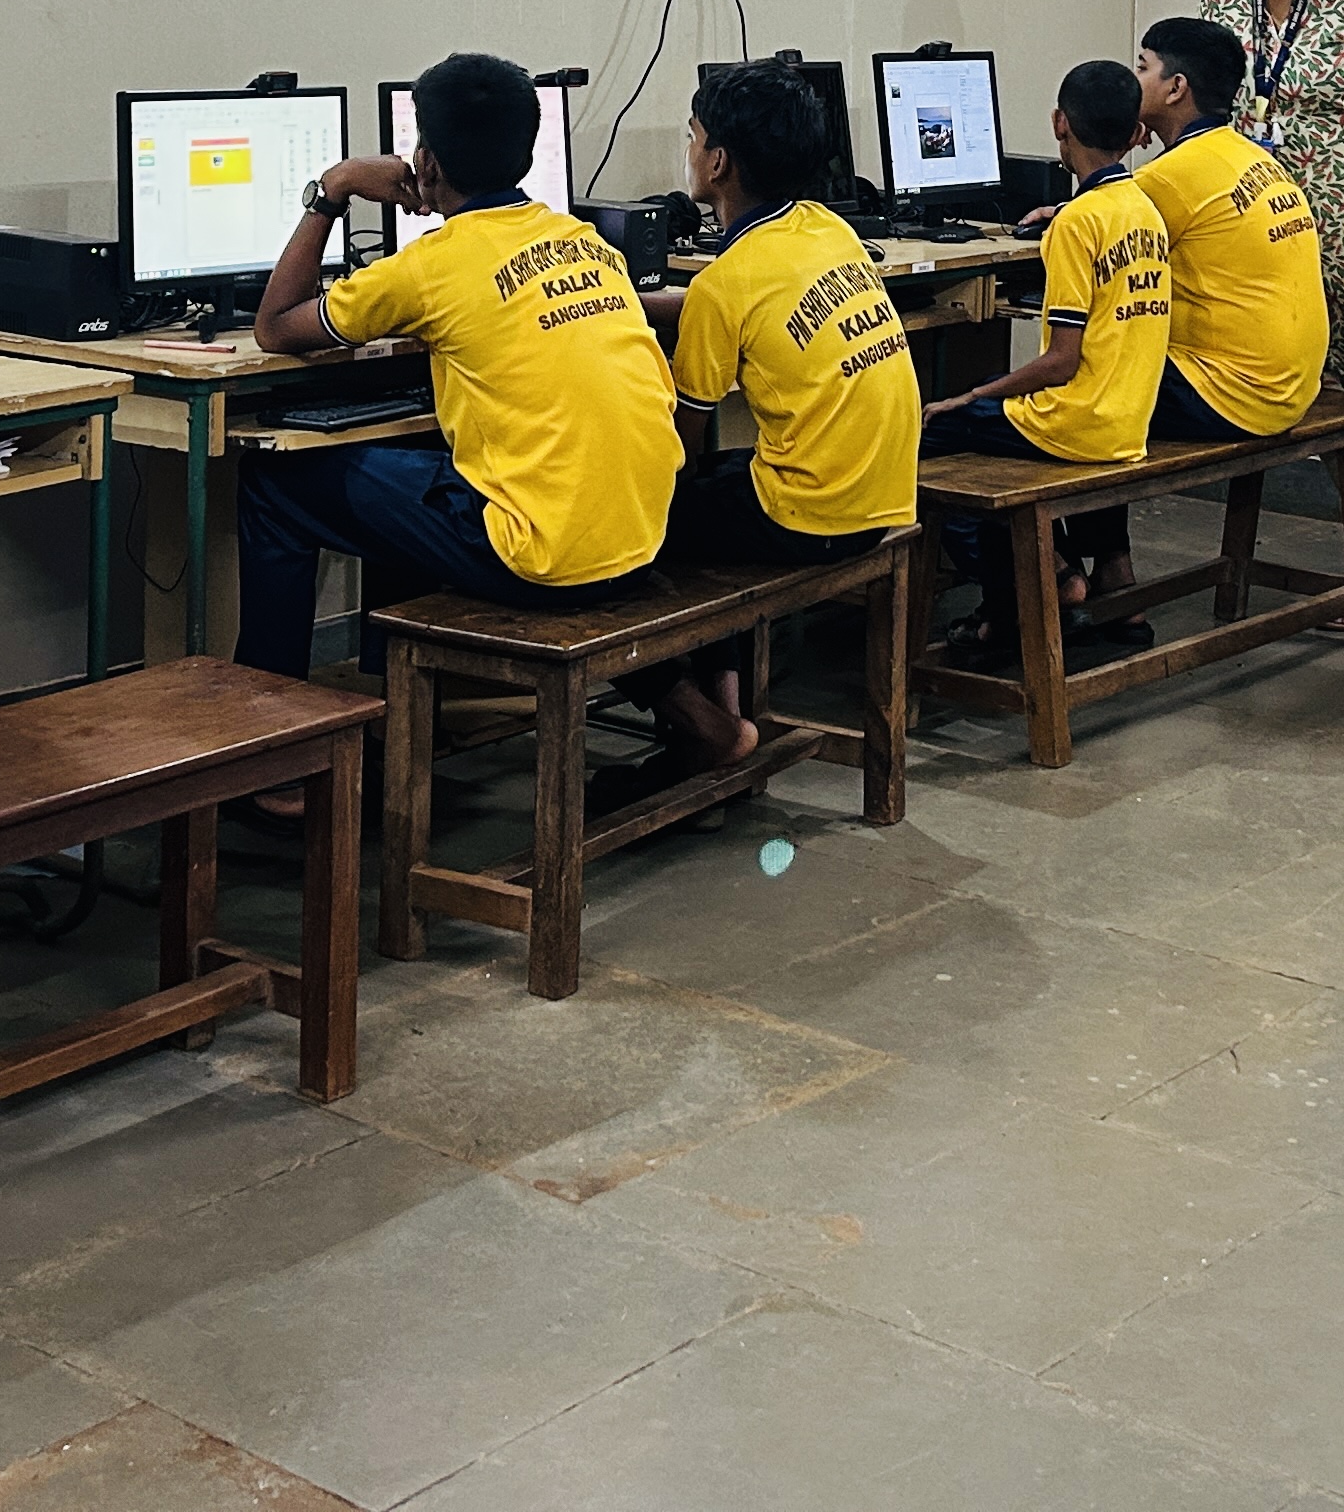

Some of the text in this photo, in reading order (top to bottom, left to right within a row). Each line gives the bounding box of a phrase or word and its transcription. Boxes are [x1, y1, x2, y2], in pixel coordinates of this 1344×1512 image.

[1230, 185, 1252, 215] PM
[1268, 190, 1302, 215] KALAY
[494, 264, 517, 302] PM
[510, 249, 539, 286] SHRI
[541, 269, 602, 299] KALAY
[1093, 253, 1111, 288] PM
[538, 295, 628, 330] SANGUEM-GOA
[799, 284, 834, 331] SHRI
[838, 300, 894, 342] KALAY
[786, 309, 814, 352] PM
